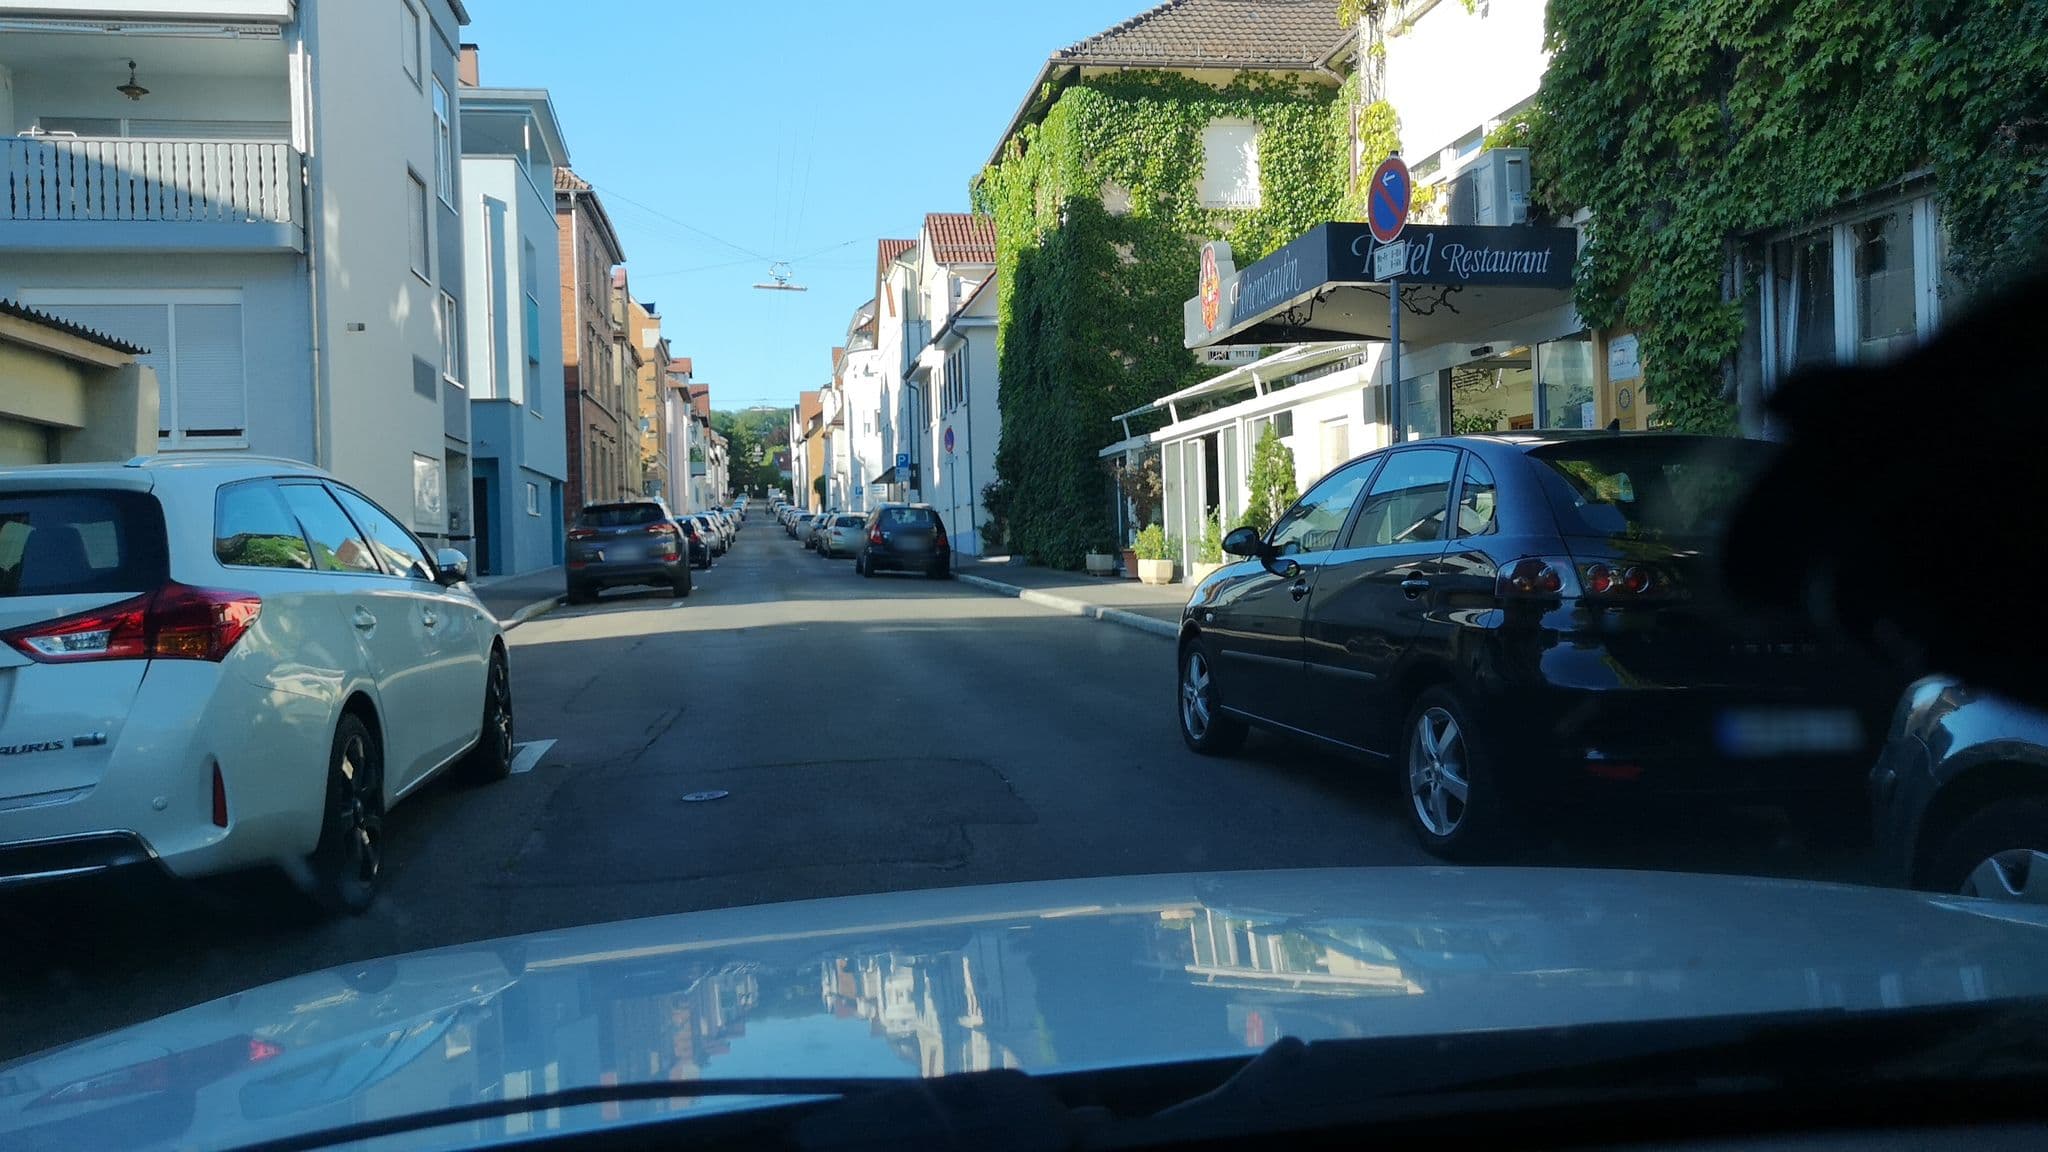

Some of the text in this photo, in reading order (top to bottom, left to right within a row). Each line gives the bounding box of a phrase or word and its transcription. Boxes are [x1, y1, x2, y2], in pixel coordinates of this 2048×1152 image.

[1351, 232, 1434, 276] Htel
[1441, 243, 1551, 280] Restaurant
[1230, 250, 1302, 318] Hohenstaufen
[898, 455, 906, 467] P
